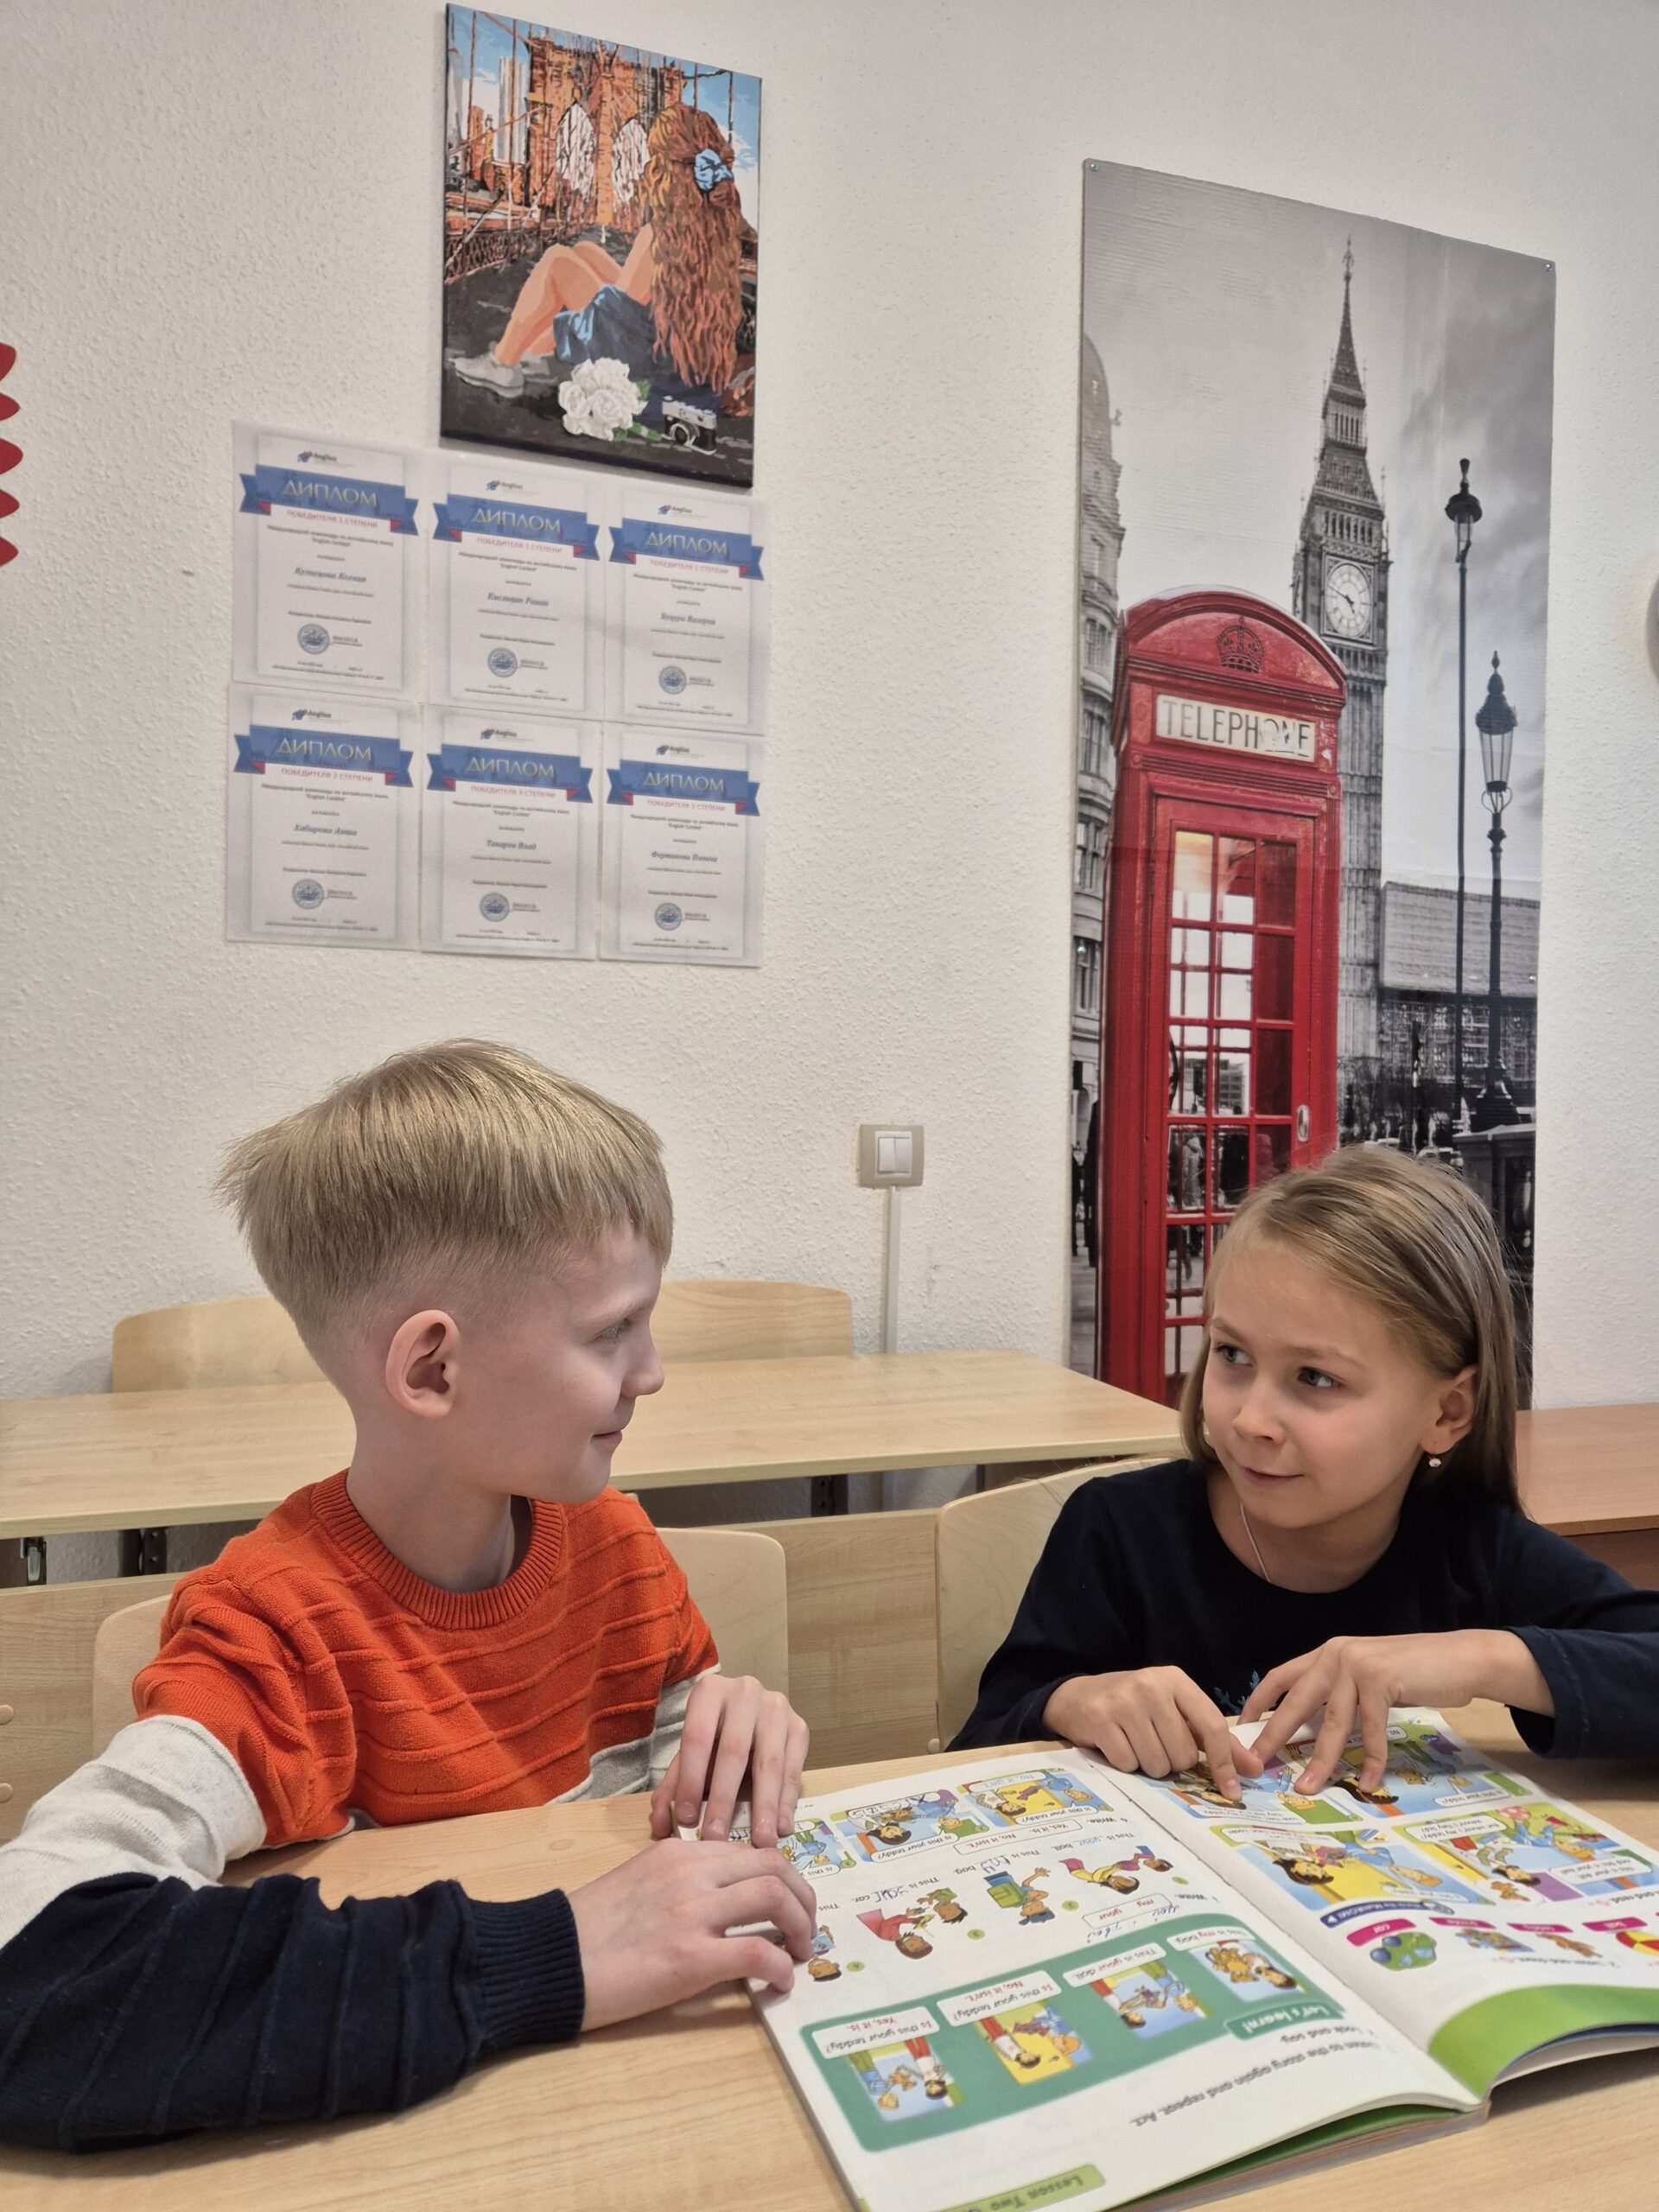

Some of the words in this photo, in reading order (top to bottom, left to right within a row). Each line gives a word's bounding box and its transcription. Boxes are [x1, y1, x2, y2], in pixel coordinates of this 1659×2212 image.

[283, 479, 378, 507] ДИПЛОМ
[472, 507, 562, 534] ДИПЛОМ
[646, 531, 728, 556] ДИПЛОМ
[277, 737, 372, 761] ДИПЛОМ
[467, 756, 555, 779] ДИПЛОМ
[644, 772, 725, 792] ДИПЛОМ
[1021, 1813, 1049, 1823] teddy?
[1049, 1822, 1070, 1831] Yes,
[998, 1833, 1016, 1842] No,
[1115, 1832, 1135, 1840] This
[907, 1840, 926, 1852] your
[927, 1837, 944, 1847] this
[966, 1837, 991, 1848] isn't.
[876, 1847, 906, 1860] teddy?
[1020, 1848, 1040, 1858] This
[806, 1867, 823, 1877] this
[952, 1864, 976, 1874] bag.
[908, 1882, 917, 1891] is
[918, 1875, 940, 1887] This
[851, 1894, 871, 1904] car.
[817, 1901, 840, 1912] This
[1099, 1908, 1122, 1921] your
[994, 1994, 1018, 2007] your
[873, 2017, 896, 2027] Yes,
[920, 2021, 933, 2030] Is
[847, 2024, 861, 2033] is.
[898, 2024, 919, 2034] this
[868, 2029, 895, 2042] your
[825, 2038, 867, 2054] teddy?
